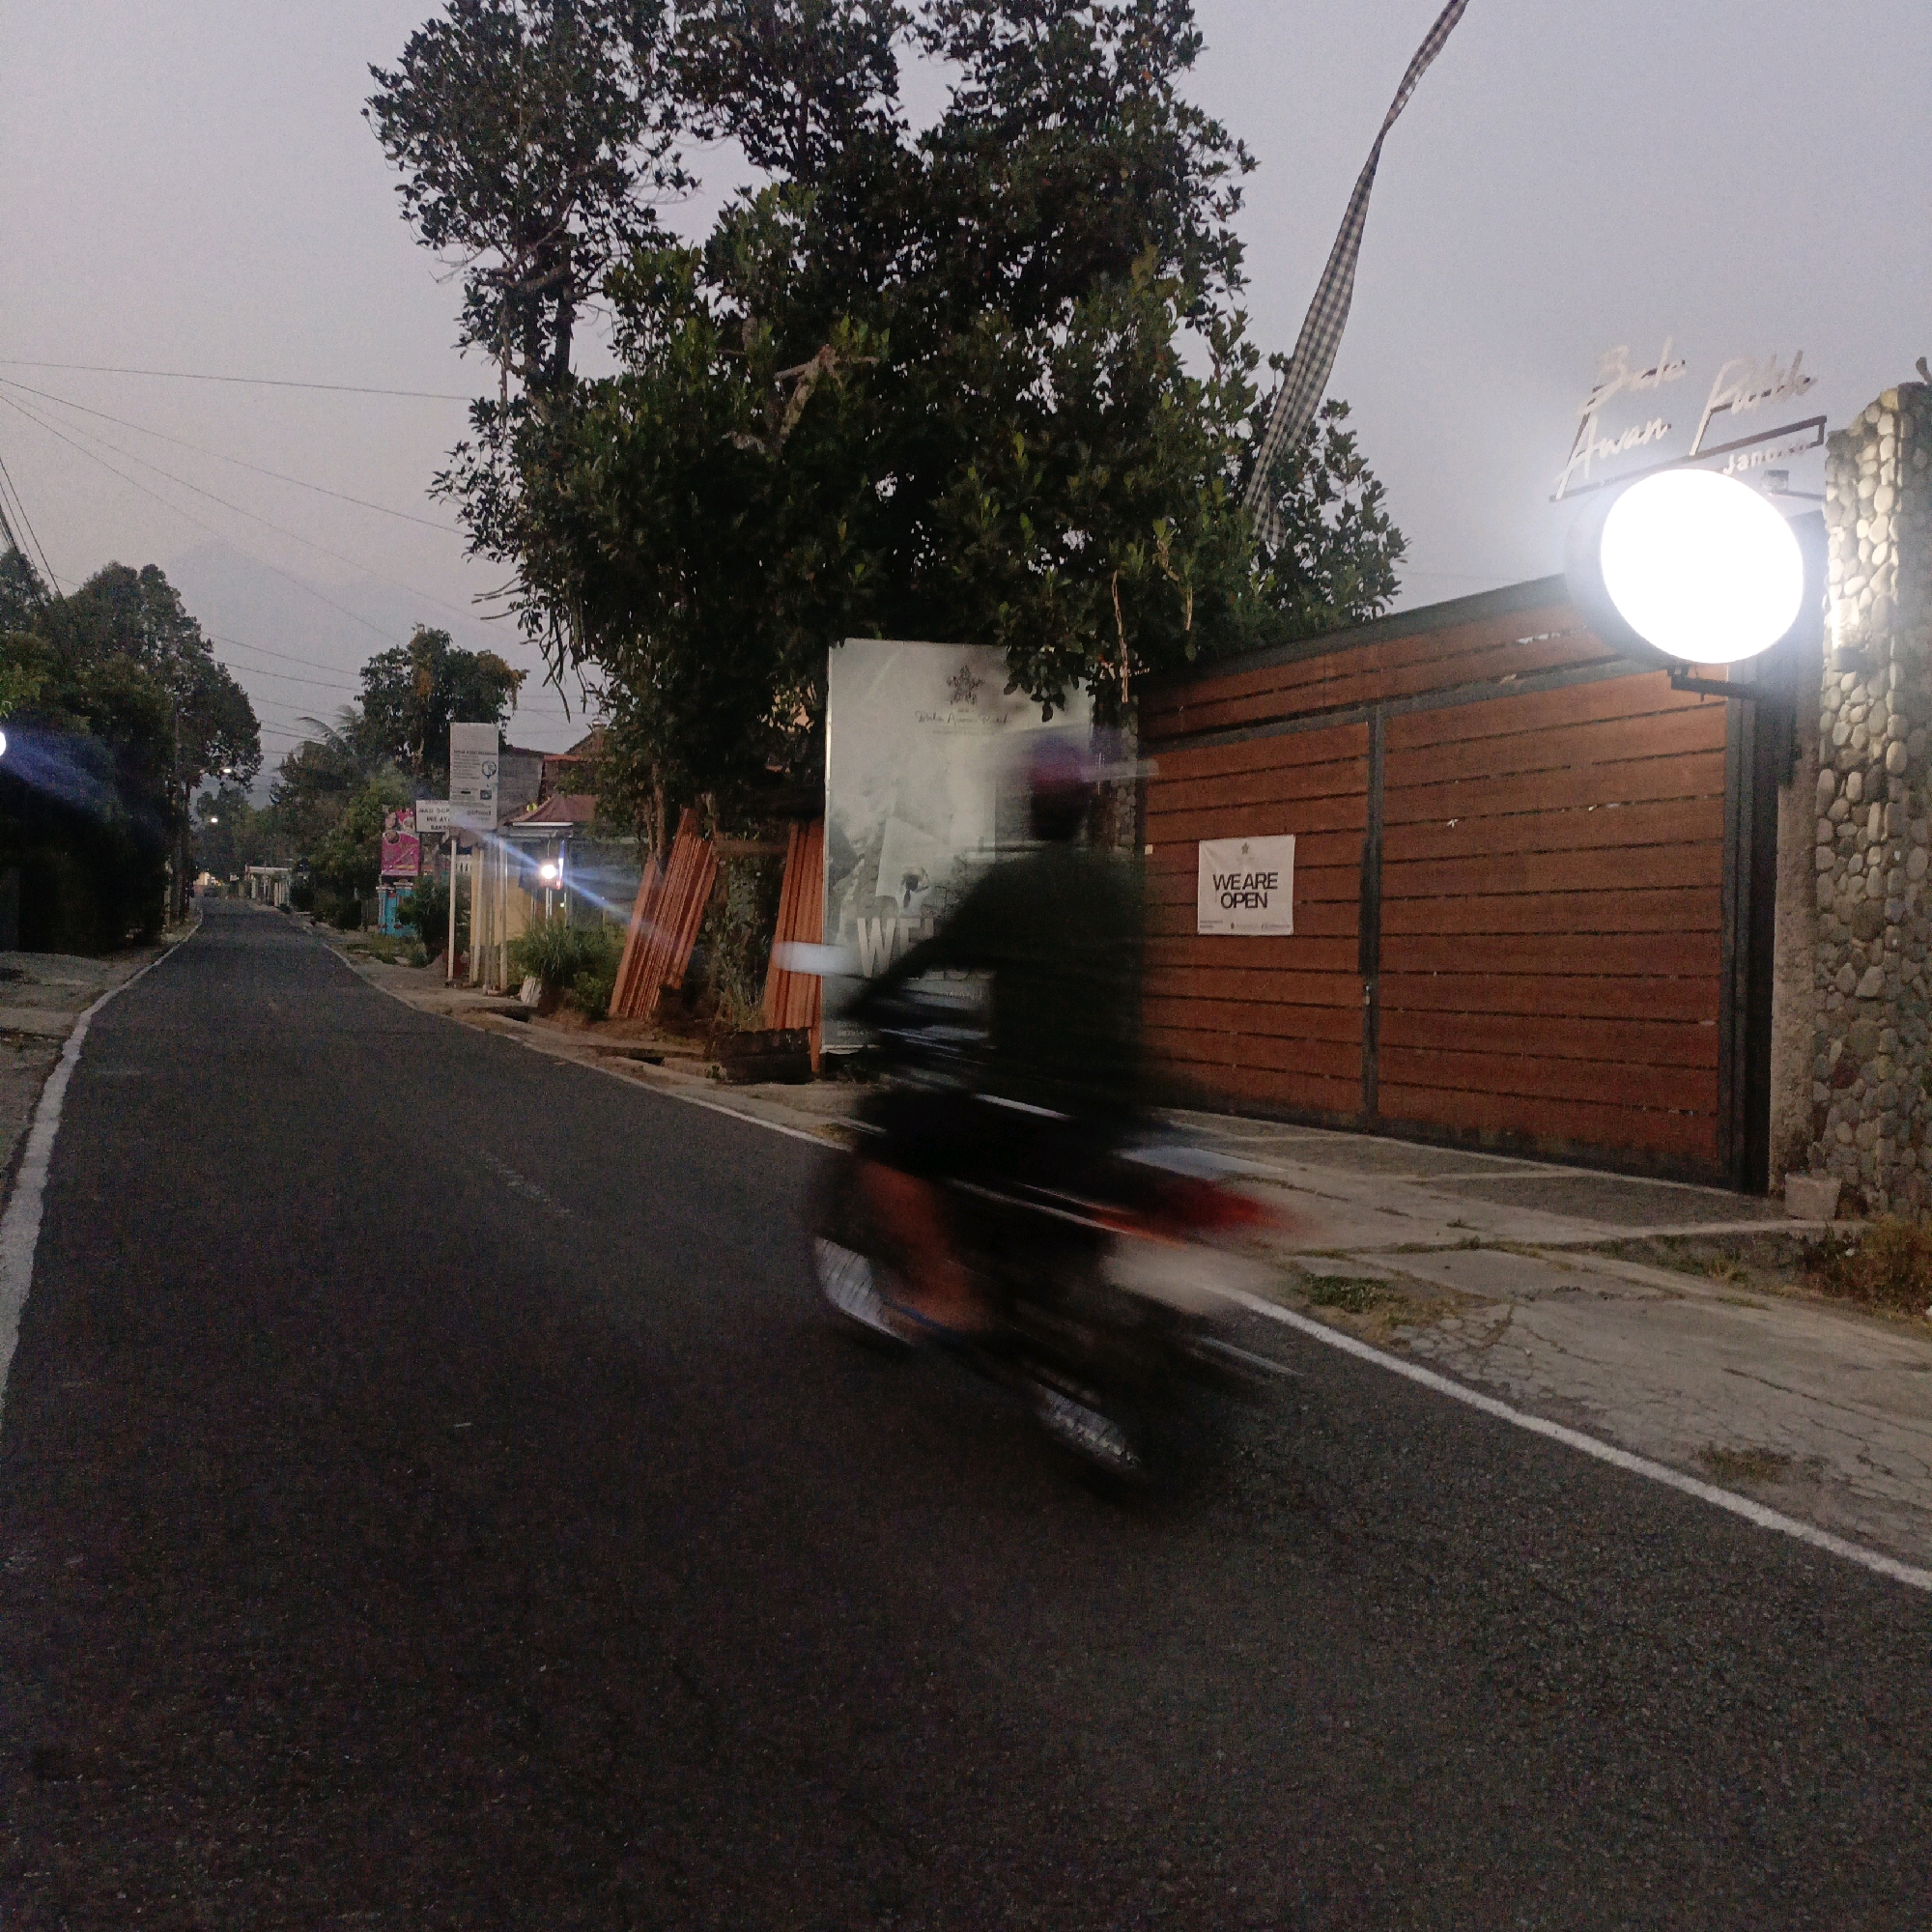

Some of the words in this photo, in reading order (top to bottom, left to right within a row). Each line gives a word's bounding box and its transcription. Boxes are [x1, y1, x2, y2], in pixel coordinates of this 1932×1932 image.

[1554, 412, 1670, 500] Awan
[1212, 872, 1241, 891] WE
[1242, 871, 1279, 890] ARE
[1220, 891, 1268, 909] OPEN
